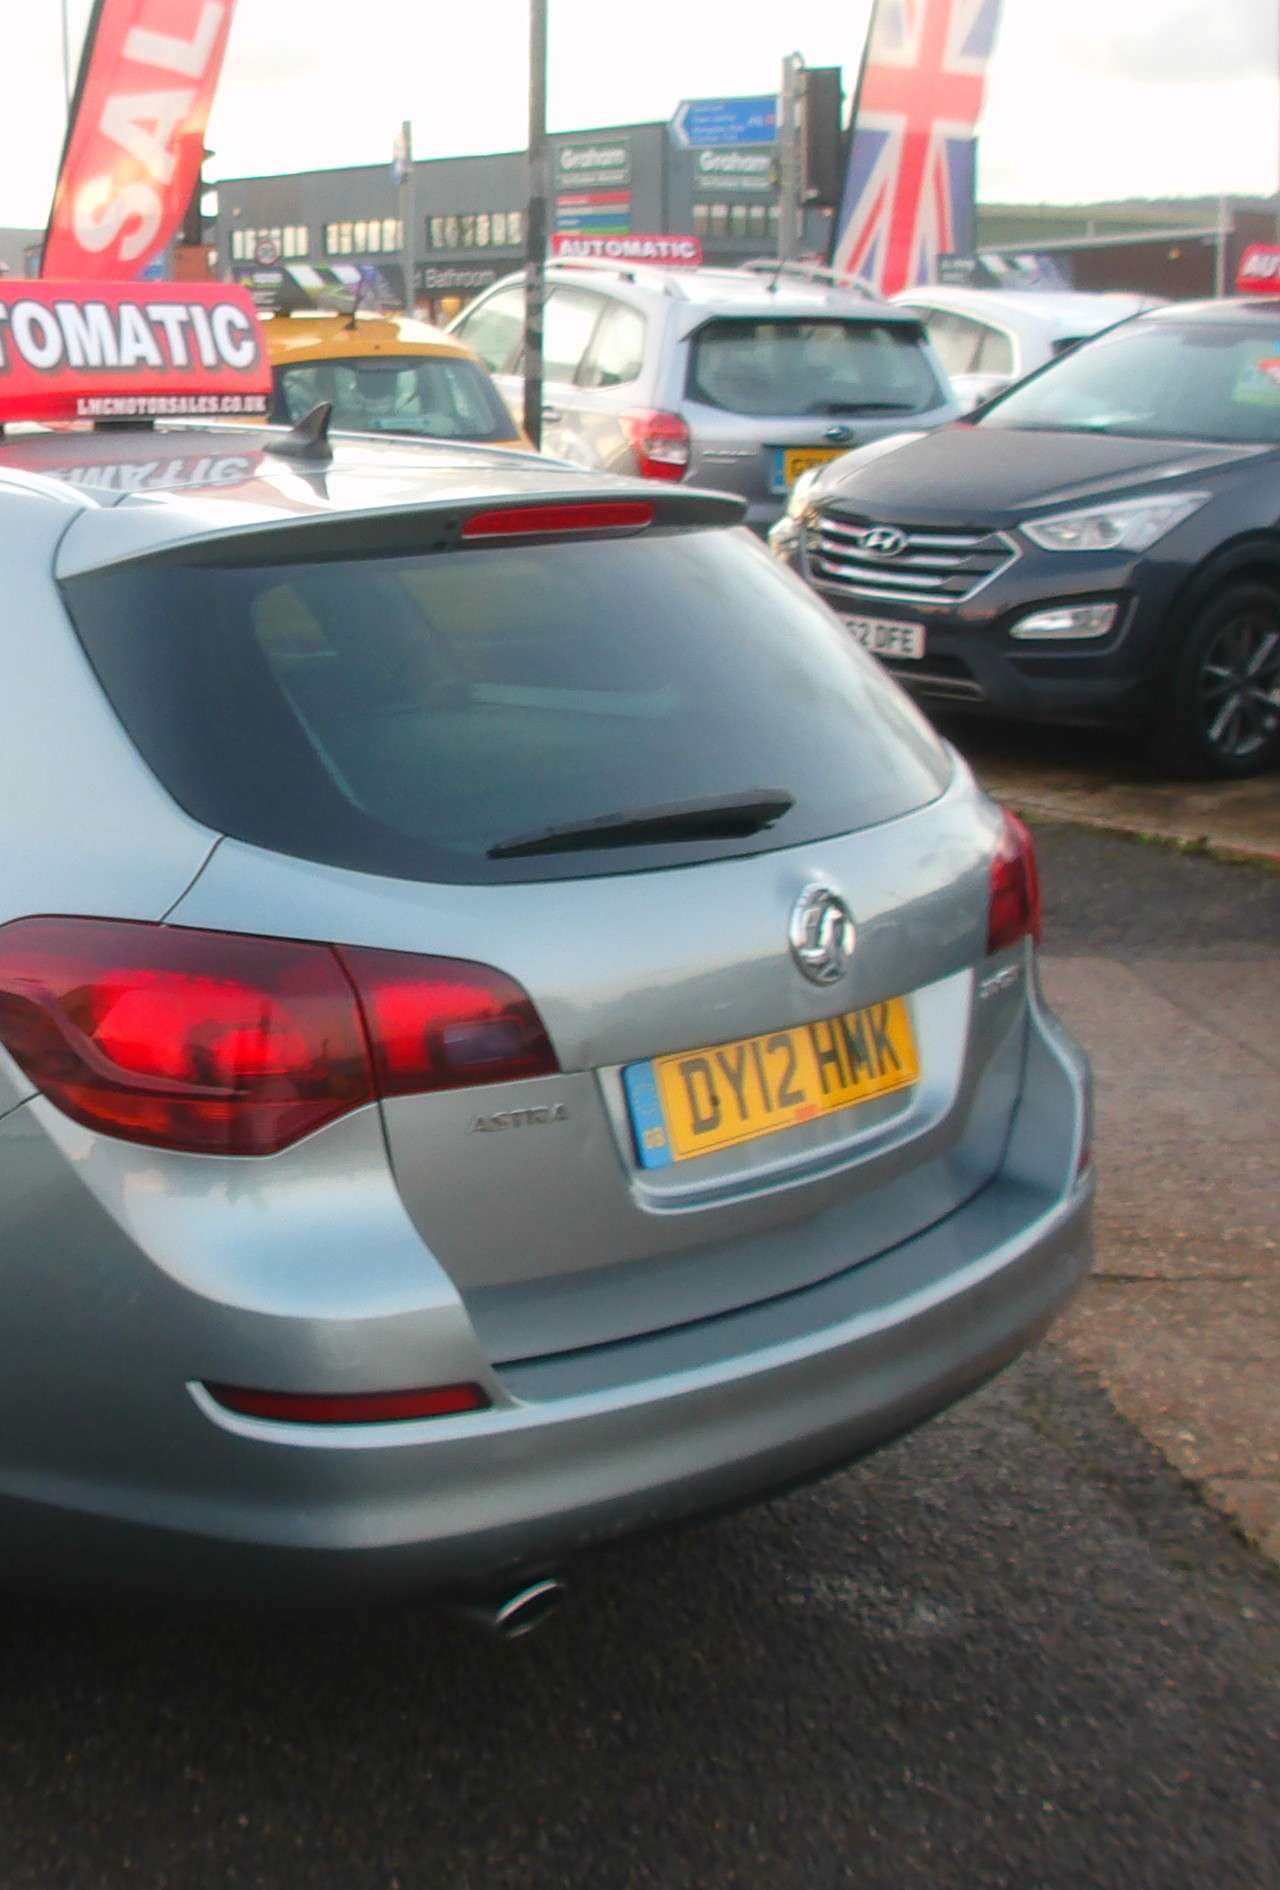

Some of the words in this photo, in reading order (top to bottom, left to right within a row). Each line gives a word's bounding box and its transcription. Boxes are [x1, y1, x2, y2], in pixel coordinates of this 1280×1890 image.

[560, 239, 696, 258] AUTOMATIC
[679, 1034, 806, 1136] DY12
[808, 1001, 903, 1095] HMK
[471, 1103, 568, 1132] ASTRA
